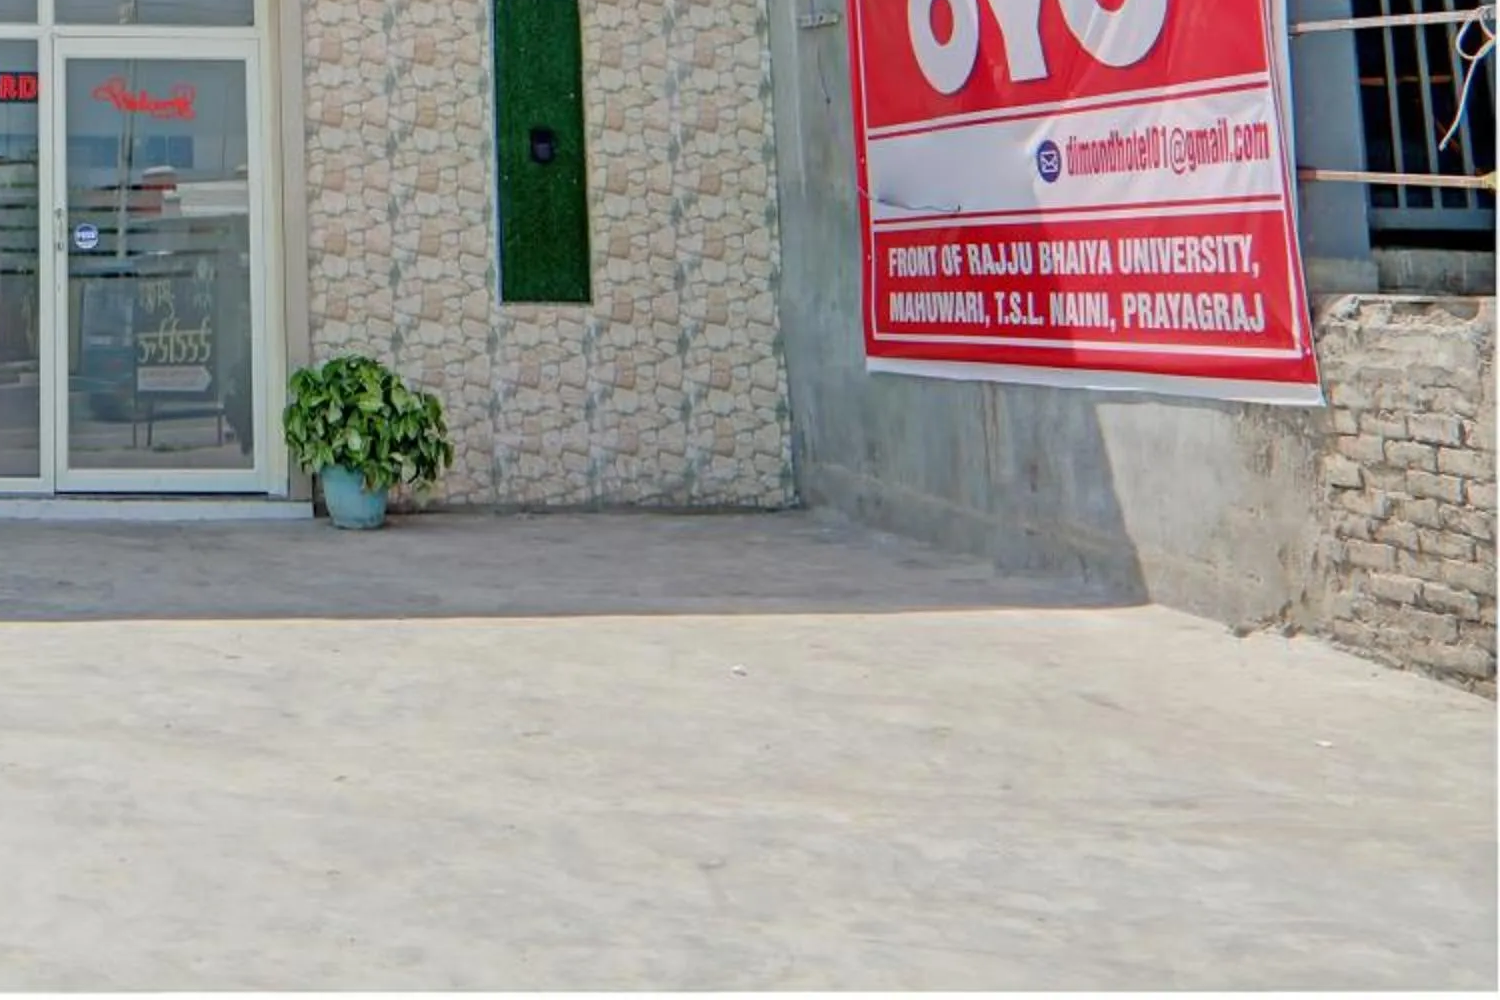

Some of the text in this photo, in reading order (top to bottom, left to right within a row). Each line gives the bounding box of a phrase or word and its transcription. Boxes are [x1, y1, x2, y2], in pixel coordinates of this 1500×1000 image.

[1066, 117, 1270, 176] dimondhotel01@gmail.com
[888, 234, 1260, 278] FRONT OF RAJJU BHAIYA UNIVERSITY,
[888, 291, 1266, 333] MAHUWARI, T.S.L. NAINI, PRAYAGRAJ
